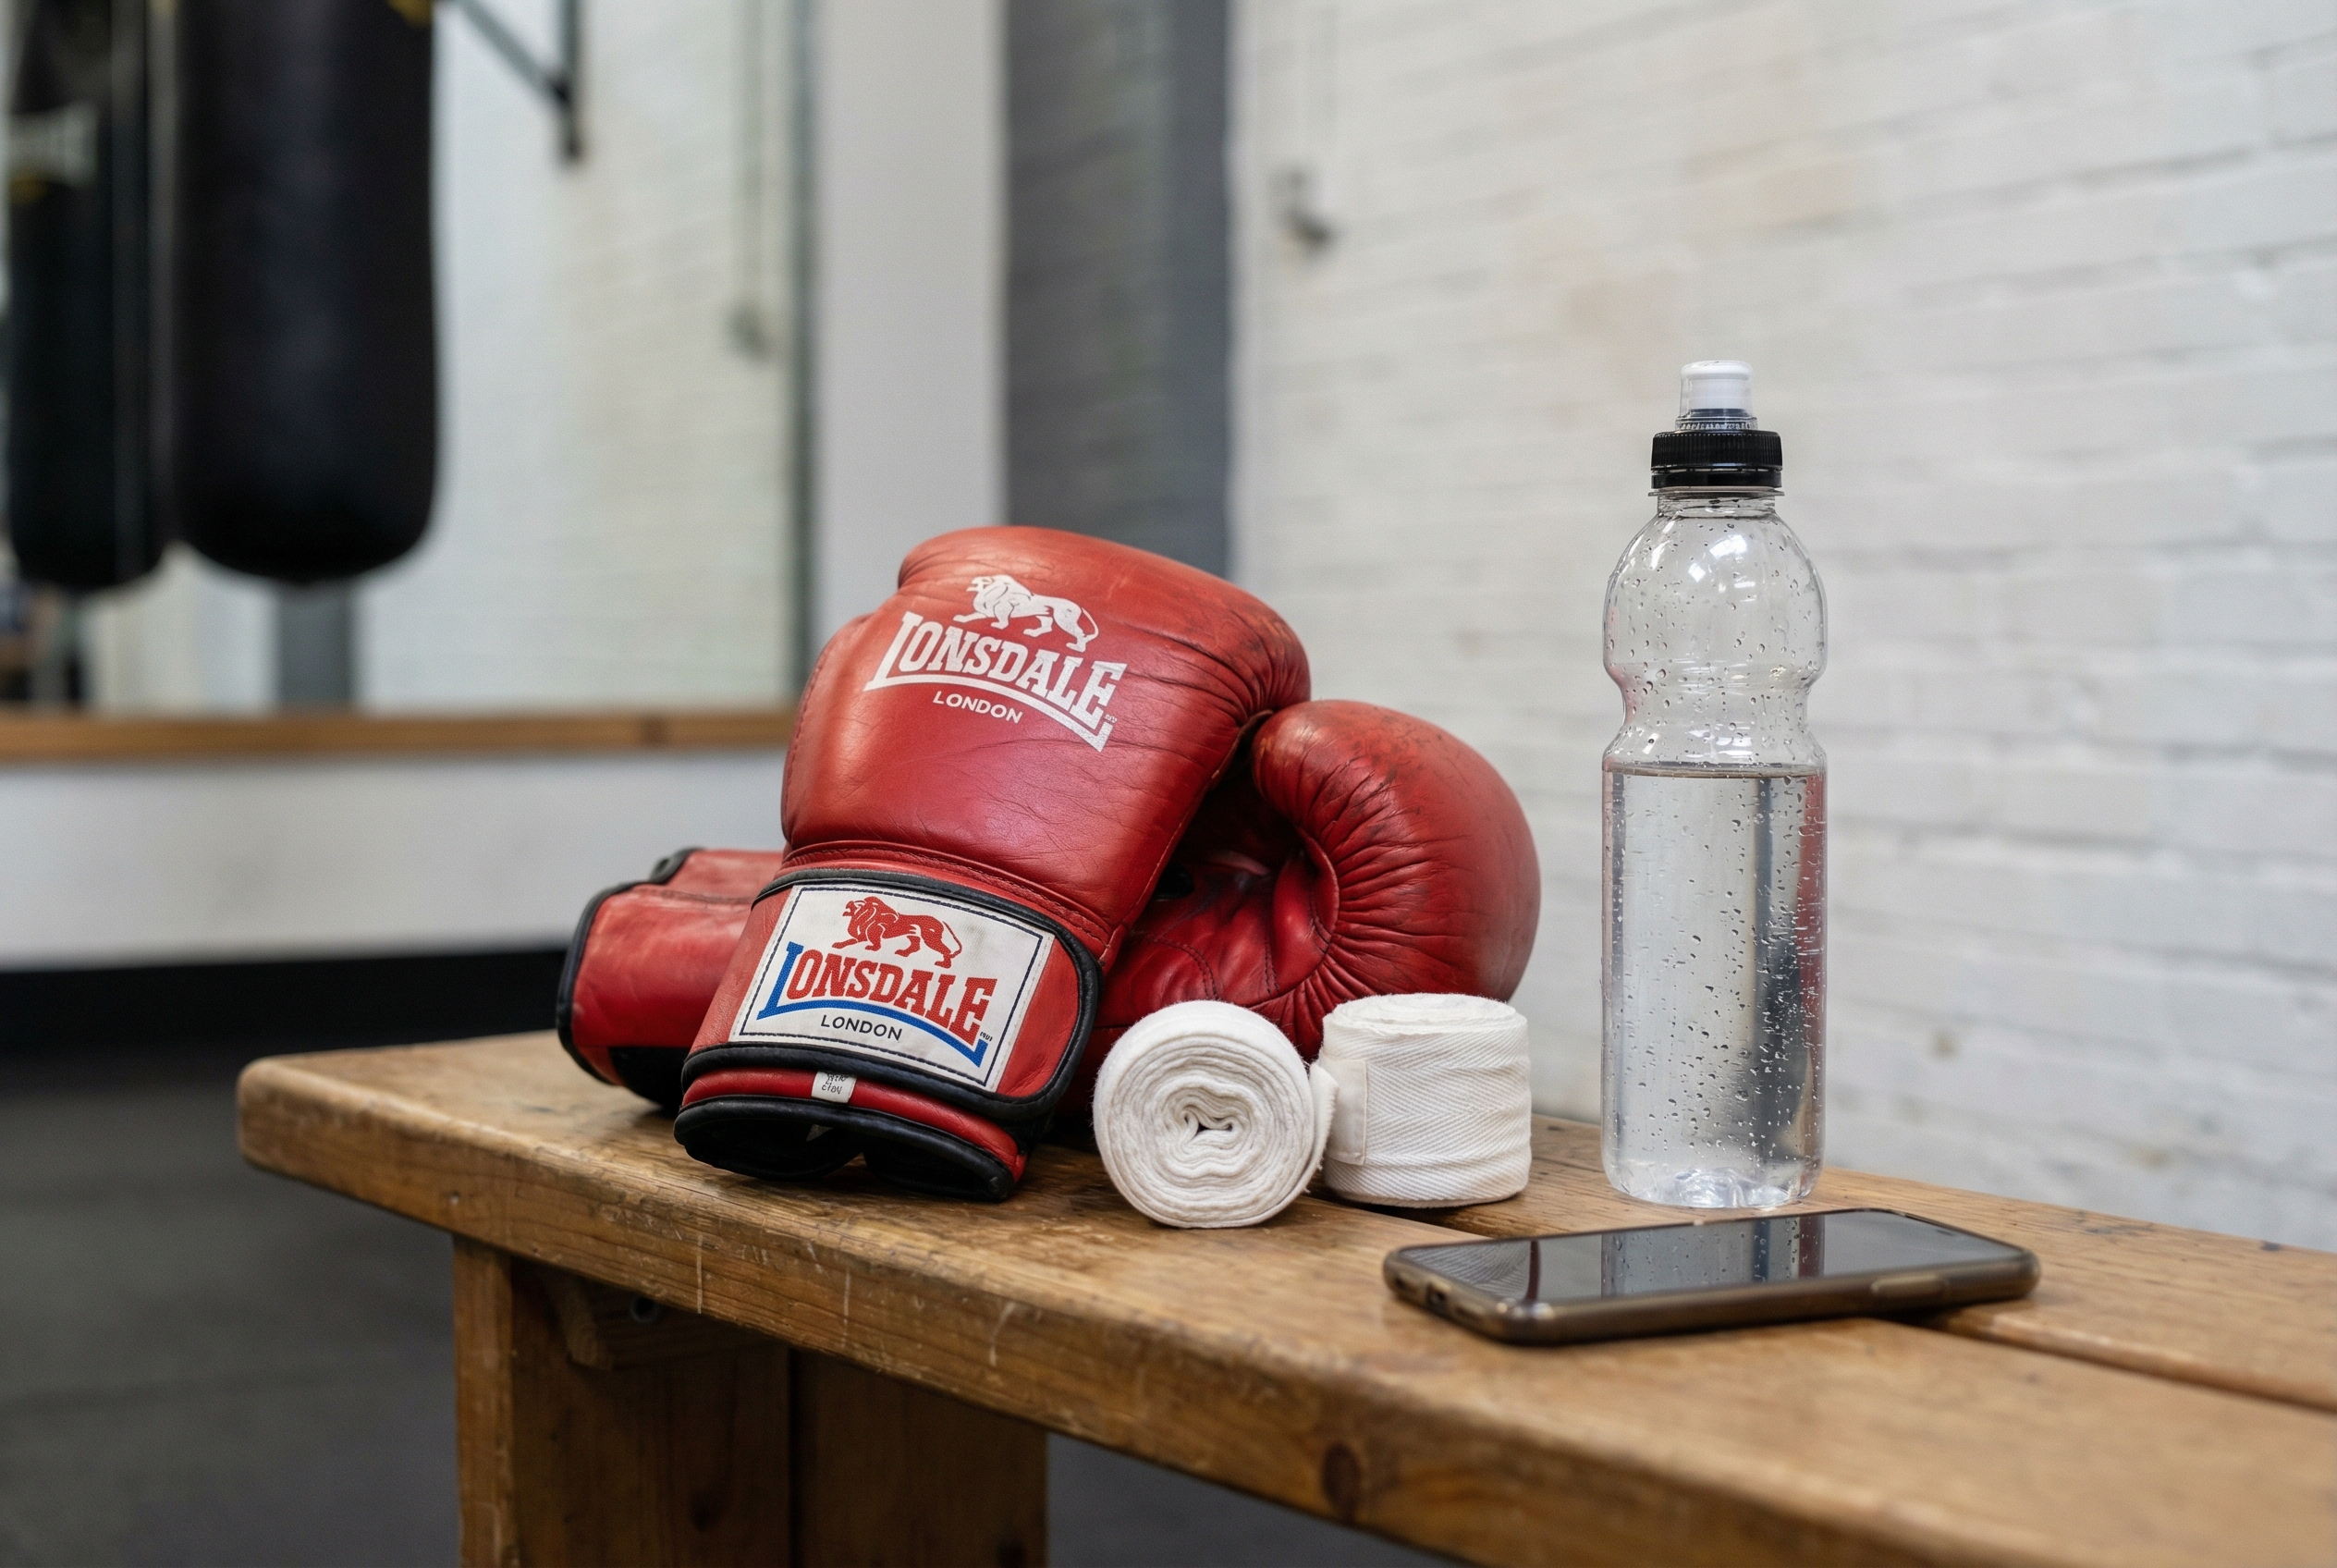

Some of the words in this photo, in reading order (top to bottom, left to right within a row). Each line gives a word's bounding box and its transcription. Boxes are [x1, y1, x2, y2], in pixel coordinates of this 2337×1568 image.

[863, 610, 1128, 753] LONSDALE
[932, 691, 1023, 724] LONDON
[756, 940, 998, 1068] LONSDALE
[820, 1014, 903, 1041] LONDON
